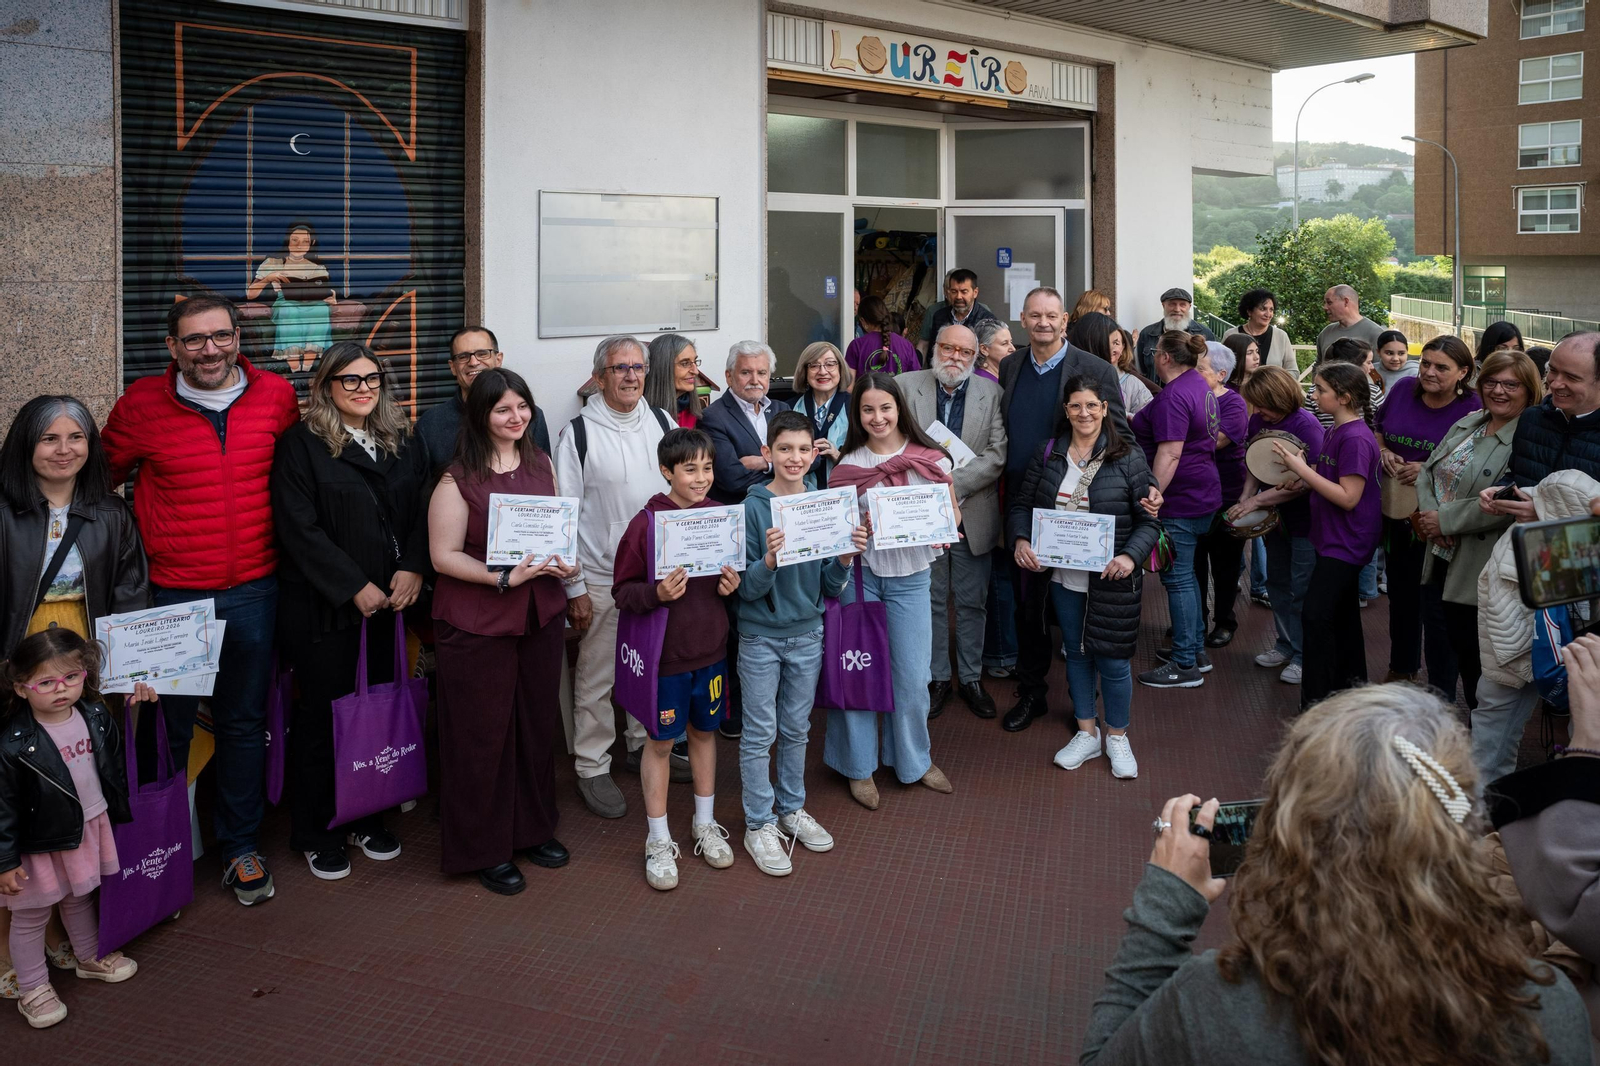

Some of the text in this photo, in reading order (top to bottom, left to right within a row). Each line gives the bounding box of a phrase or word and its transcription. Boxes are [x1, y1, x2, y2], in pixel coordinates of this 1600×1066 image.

[830, 29, 1027, 95] LOUREIRO
[1385, 432, 1436, 451] LOUREIR
[130, 621, 157, 630] CERTAME
[160, 615, 191, 625] LITERARIO
[135, 626, 164, 635] LOUREIRO
[709, 675, 722, 702] 10
[392, 749, 399, 758] do
[400, 744, 416, 756] Redor
[141, 857, 162, 870] Xente
